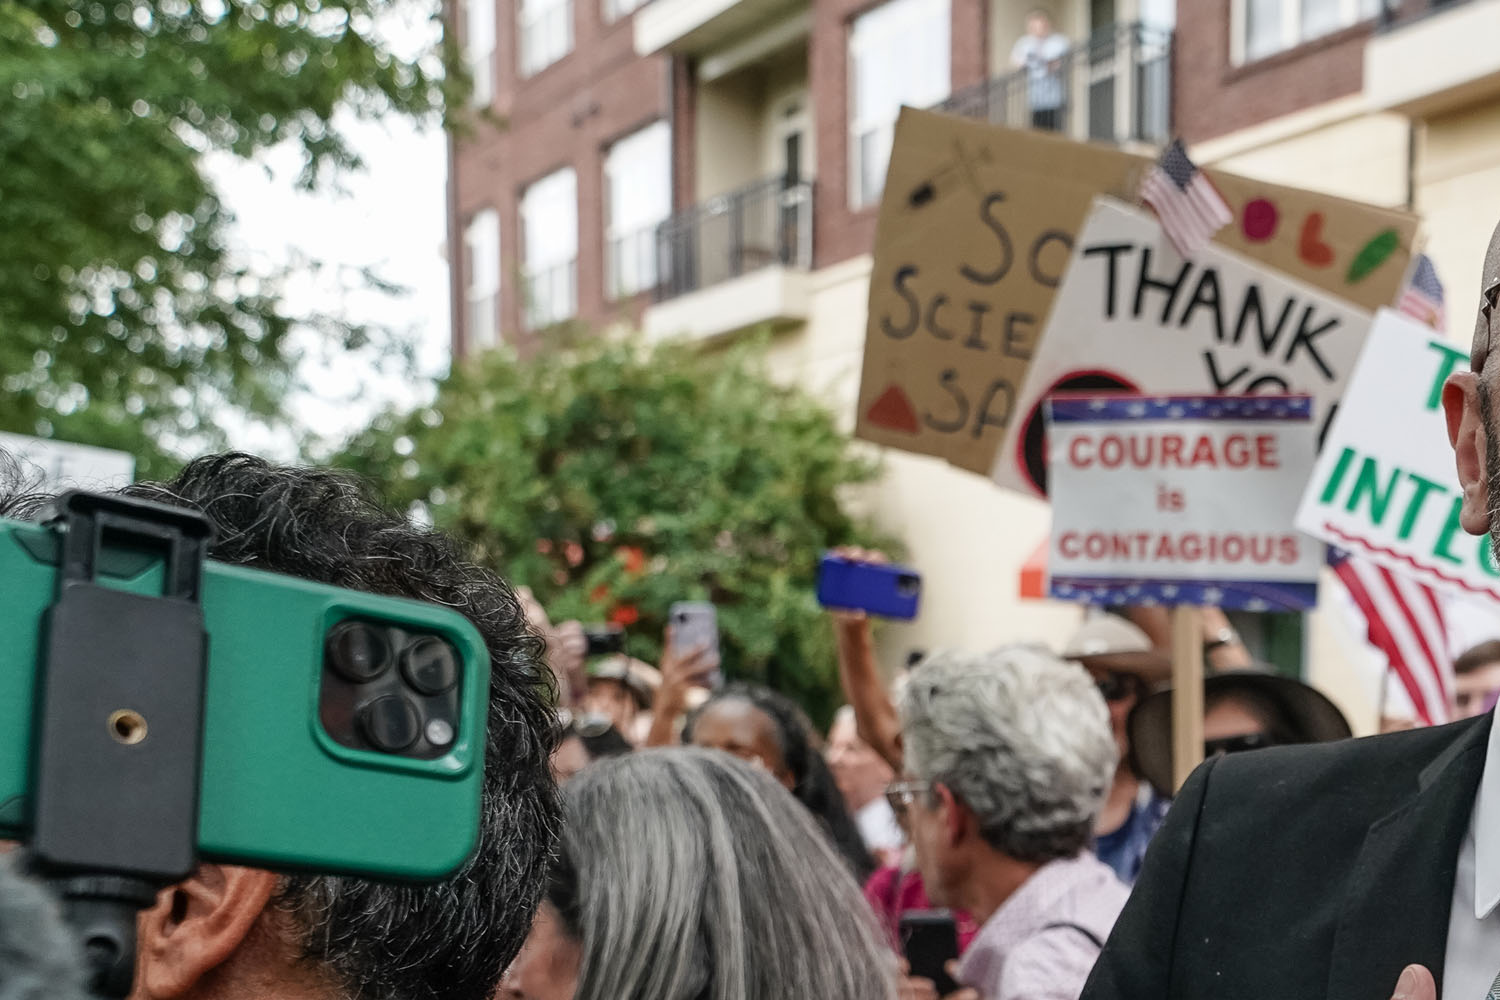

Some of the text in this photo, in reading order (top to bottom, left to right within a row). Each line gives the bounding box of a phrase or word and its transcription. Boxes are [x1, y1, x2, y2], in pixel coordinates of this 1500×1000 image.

[1083, 243, 1340, 381] THANK
[1068, 434, 1280, 470] COURAGE
[1156, 480, 1186, 512] is
[1058, 532, 1300, 565] CONTAGIOUS
